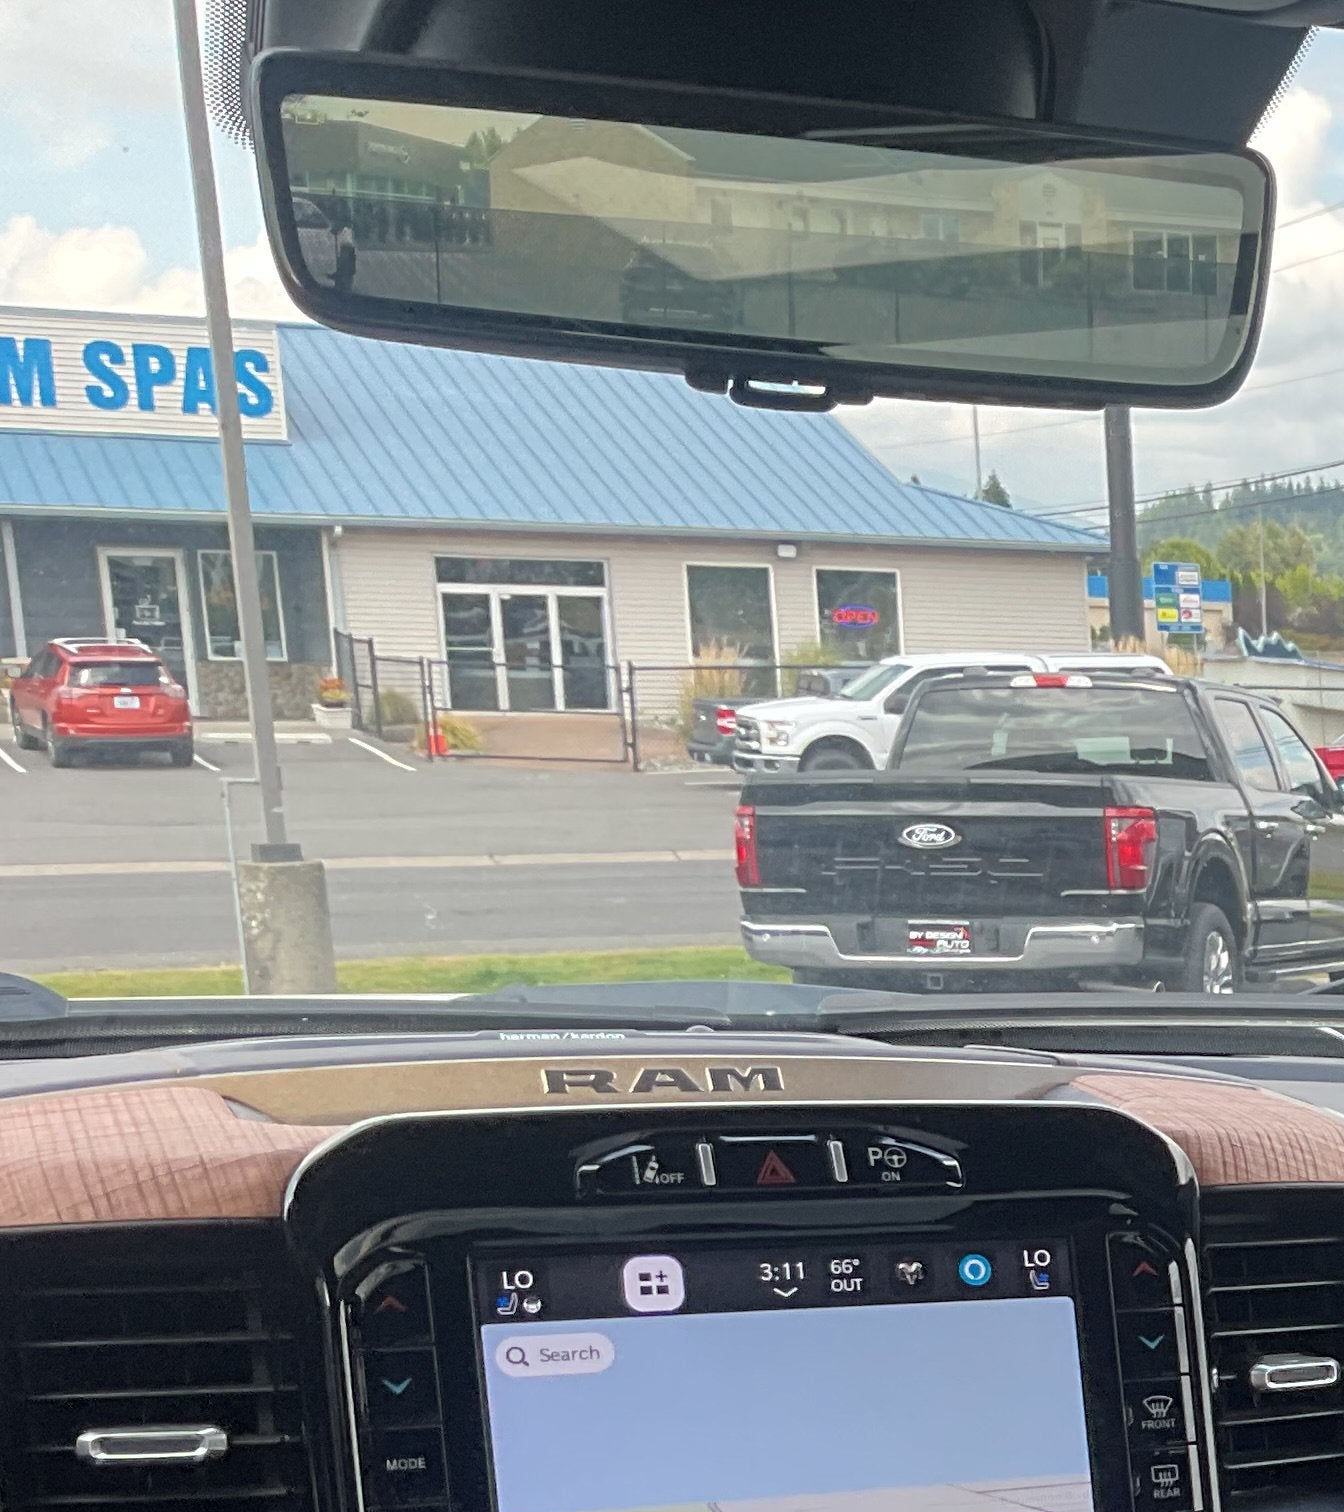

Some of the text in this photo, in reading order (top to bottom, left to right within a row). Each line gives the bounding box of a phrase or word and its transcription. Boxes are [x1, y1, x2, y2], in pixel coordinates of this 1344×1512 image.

[81, 340, 275, 418] SPAS
[832, 609, 878, 624] OPEN
[911, 827, 946, 841] Ford
[936, 939, 970, 949] AUTO
[541, 1067, 785, 1094] RAM
[660, 1171, 685, 1184] OFF
[881, 1171, 901, 1183] ON
[1023, 1249, 1050, 1268] LO
[759, 1261, 805, 1281] 3:11
[830, 1258, 862, 1275] 66°
[501, 1270, 534, 1290] LO
[830, 1278, 864, 1293] OUT
[539, 1344, 601, 1364] Search
[1141, 1417, 1177, 1430] FRONT
[386, 1456, 427, 1471] MODE
[1153, 1486, 1181, 1499] REAR
